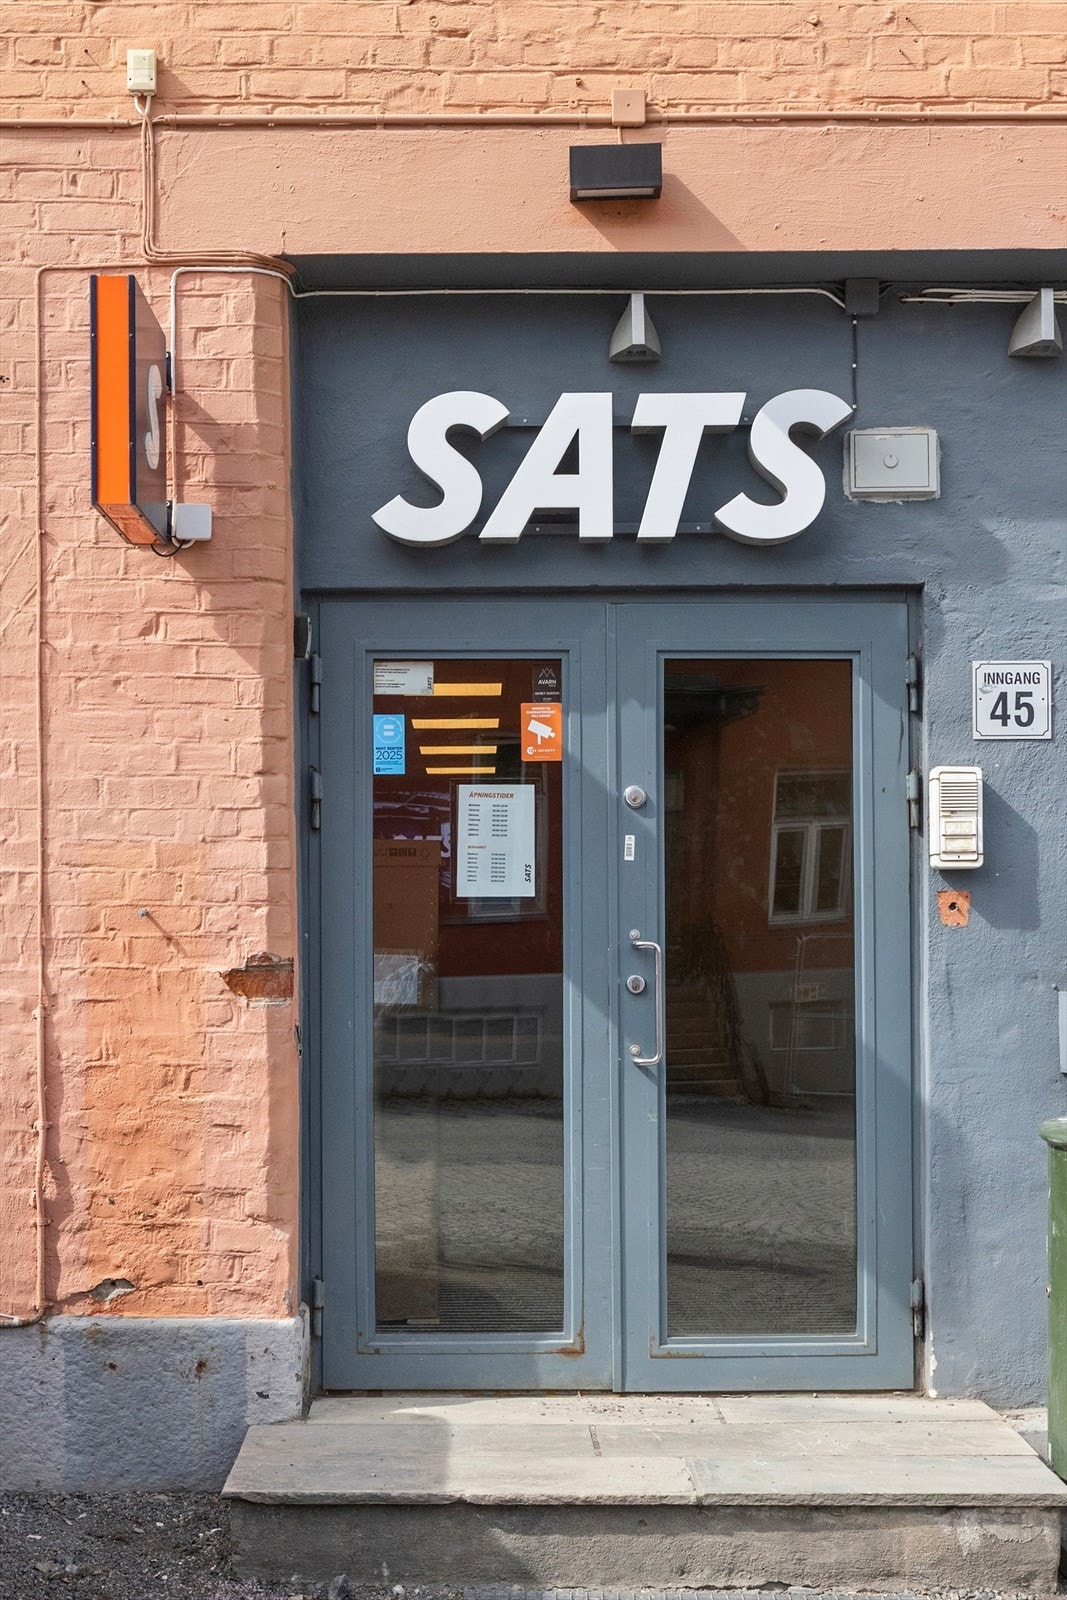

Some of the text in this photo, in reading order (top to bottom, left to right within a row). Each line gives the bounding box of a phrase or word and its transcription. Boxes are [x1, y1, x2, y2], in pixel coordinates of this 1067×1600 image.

[371, 389, 854, 547] SATS
[983, 672, 1041, 685] INNGANG
[990, 691, 1035, 727] 45
[375, 750, 403, 760] 2025
[469, 791, 514, 799] ÅPNINGSTIDER
